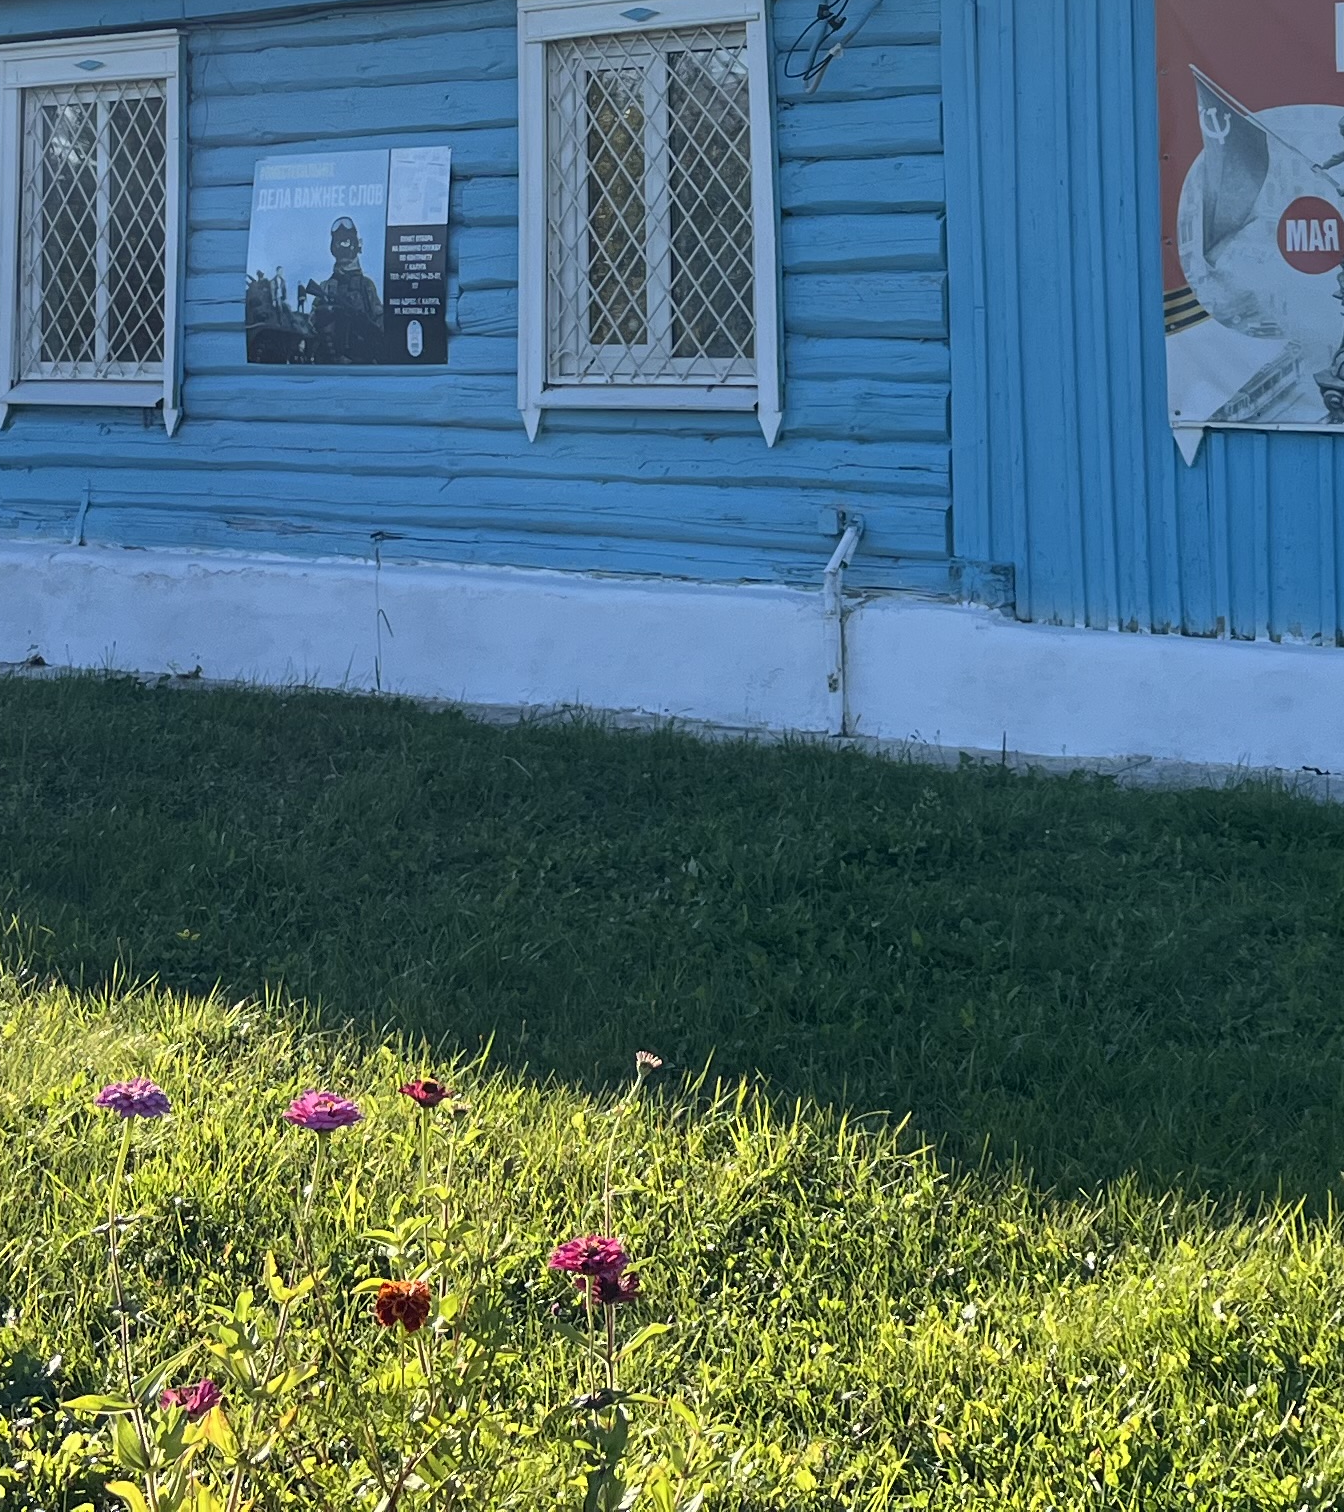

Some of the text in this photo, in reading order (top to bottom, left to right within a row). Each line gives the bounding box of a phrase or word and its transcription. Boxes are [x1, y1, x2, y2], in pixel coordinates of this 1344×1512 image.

[256, 183, 385, 211] ДЕЛА ВАЖНЕЕ СЛОВ
[1285, 219, 1340, 253] МАЯ
